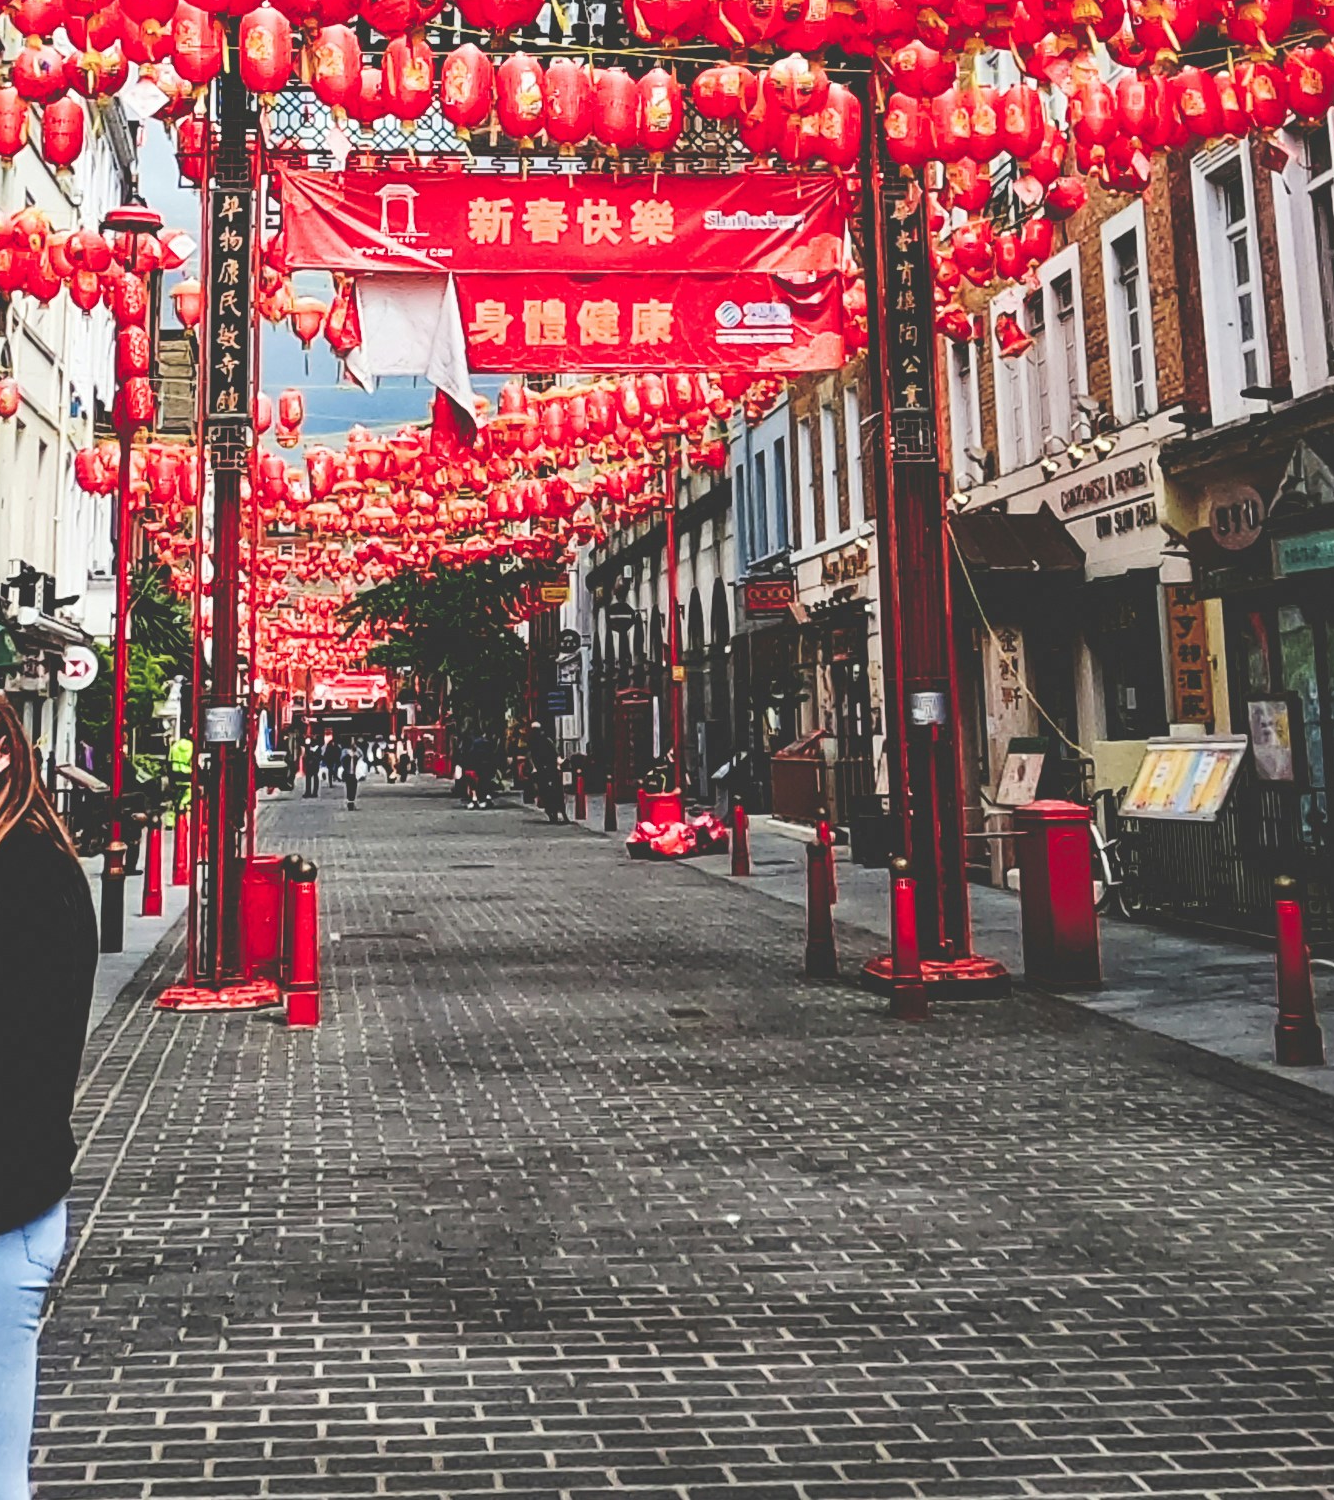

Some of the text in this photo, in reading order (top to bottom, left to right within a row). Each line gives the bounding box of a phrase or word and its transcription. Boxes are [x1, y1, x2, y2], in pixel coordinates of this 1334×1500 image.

[467, 197, 677, 245] 新春快樂
[468, 298, 675, 346] 身體健康
